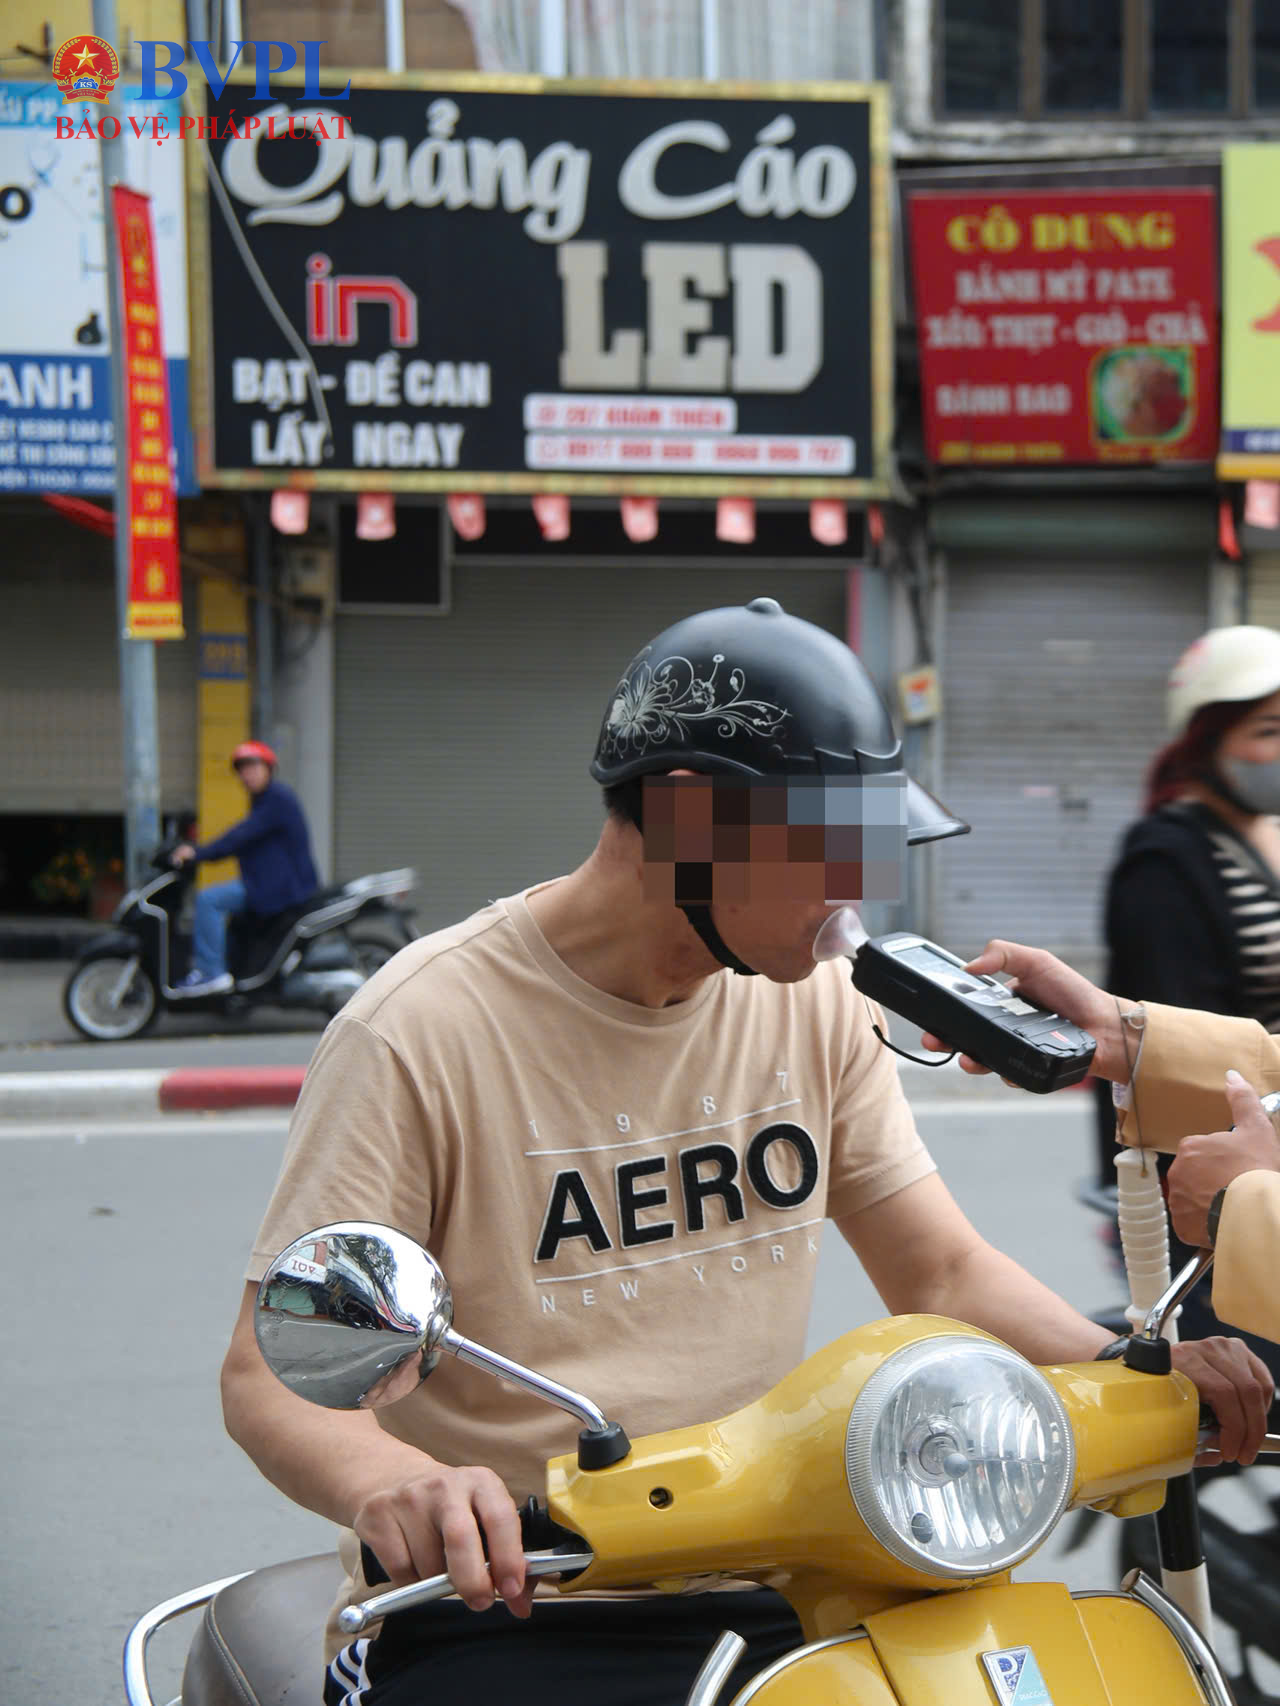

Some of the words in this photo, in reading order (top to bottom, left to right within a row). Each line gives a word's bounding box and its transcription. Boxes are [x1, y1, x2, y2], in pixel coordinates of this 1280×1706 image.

[221, 98, 592, 243] Quảng
[617, 113, 857, 220] Cáo
[947, 203, 1020, 253] CÔ
[1033, 212, 1175, 250] DUNG
[306, 252, 418, 347] in
[556, 239, 823, 392] LED
[231, 357, 308, 412] BẠT
[403, 360, 491, 408] CAN
[251, 408, 326, 467] LẤY
[352, 420, 464, 468] NGAY
[533, 1120, 820, 1264] AERO
[540, 1279, 641, 1314] NEW
[692, 1233, 820, 1284] YORK
